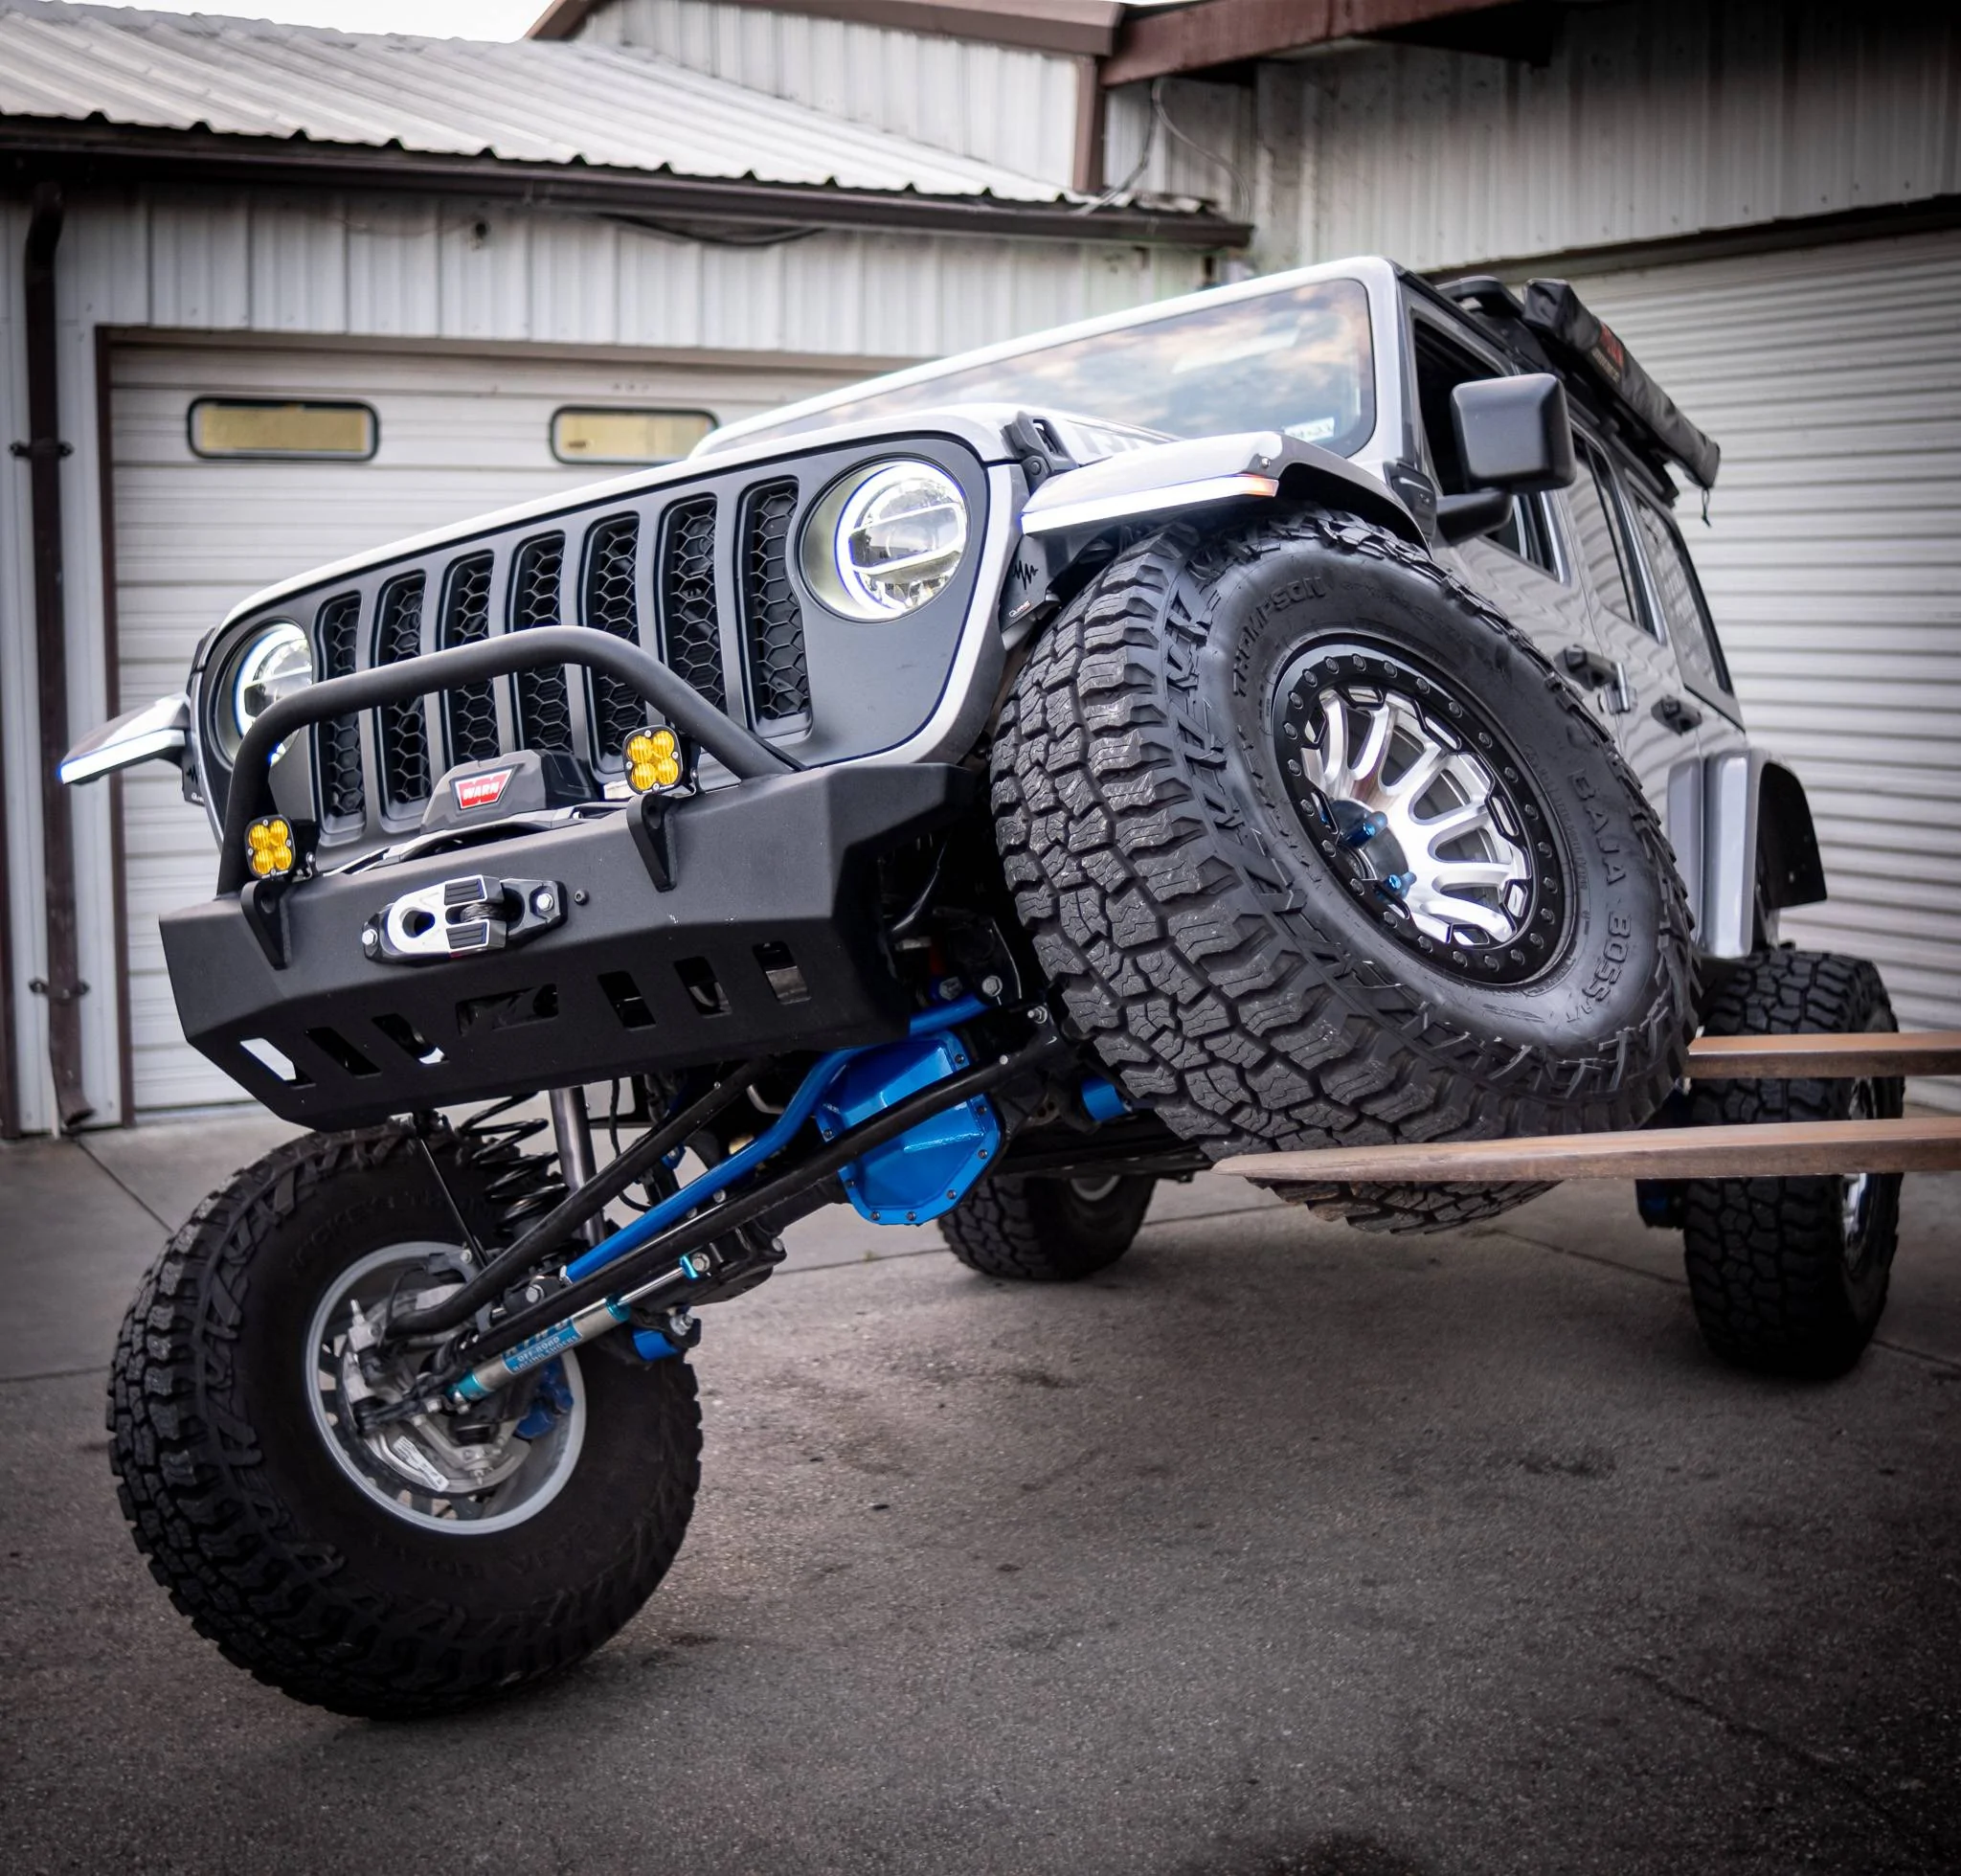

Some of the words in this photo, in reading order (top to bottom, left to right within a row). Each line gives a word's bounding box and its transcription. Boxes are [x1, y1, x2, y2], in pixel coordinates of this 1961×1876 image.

[1231, 576, 1326, 697] THOMPSON
[462, 780, 500, 801] WARN
[1567, 767, 1626, 886] BAJA
[1581, 911, 1632, 1003] BOSS
